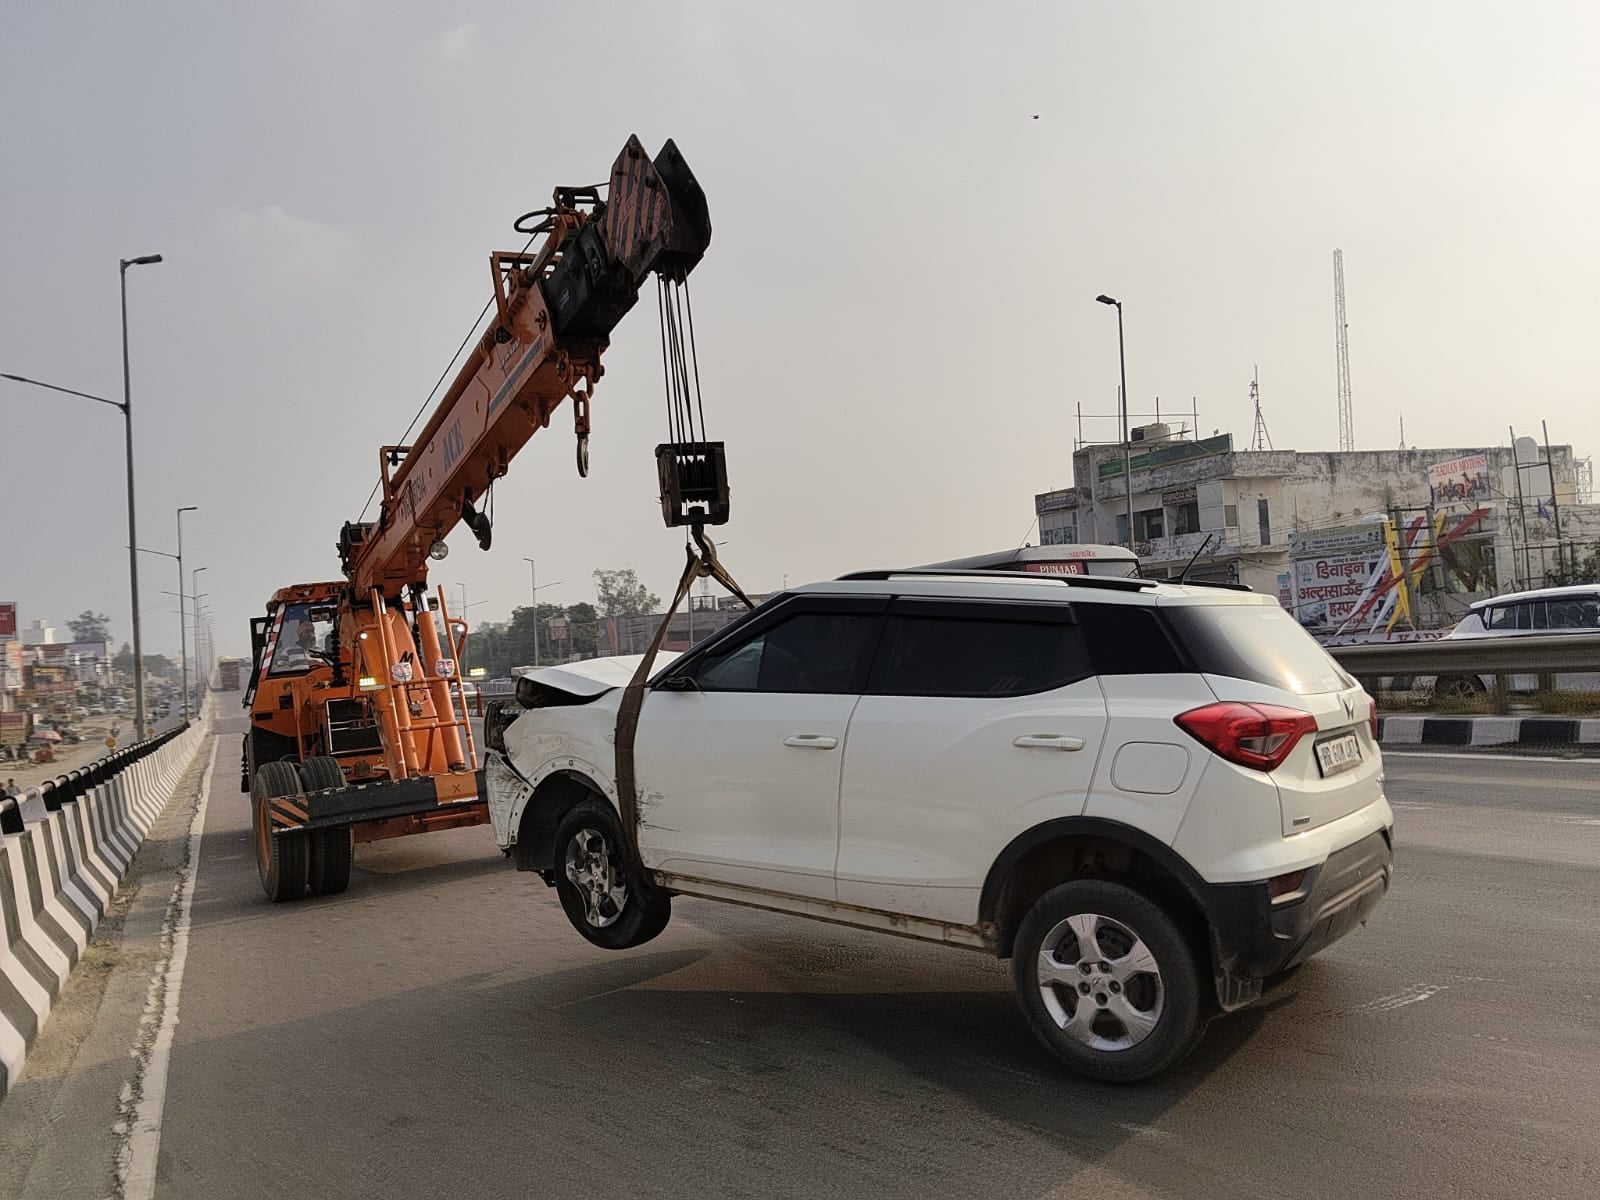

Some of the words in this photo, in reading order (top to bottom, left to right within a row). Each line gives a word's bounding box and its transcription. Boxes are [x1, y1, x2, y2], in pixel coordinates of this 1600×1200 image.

[1459, 456, 1485, 471] MOTORS
[1039, 564, 1078, 575] PUNJAB
[1315, 561, 1365, 579] डिवाइन
